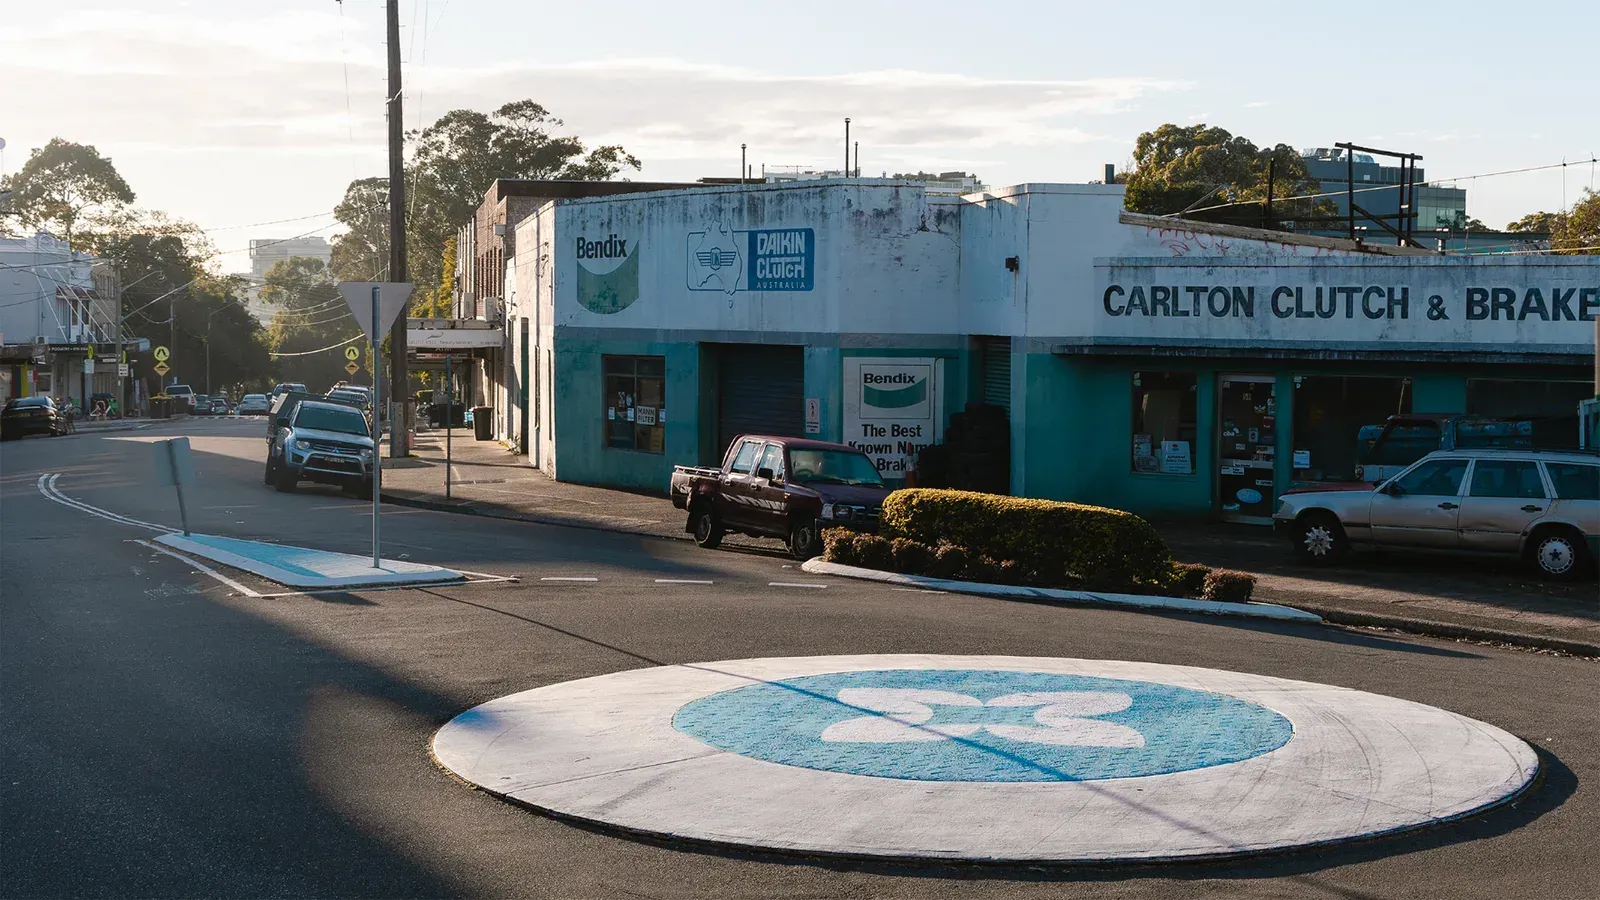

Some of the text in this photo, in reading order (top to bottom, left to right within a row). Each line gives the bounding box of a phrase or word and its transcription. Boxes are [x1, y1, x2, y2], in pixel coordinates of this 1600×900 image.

[576, 233, 628, 260] Bendix
[757, 231, 806, 256] DAIKIN
[757, 256, 805, 280] CLUTCH
[757, 281, 806, 290] AUSTRALIA
[1103, 284, 1255, 318] CARLTON
[1270, 285, 1408, 321] CLUTCH
[1426, 294, 1450, 321] &
[863, 373, 916, 384] Bendix
[637, 407, 655, 416] MANN
[637, 415, 655, 424] FILTER
[861, 424, 922, 437] The Best
[897, 441, 937, 454] Nm
[876, 457, 908, 472] Brak
